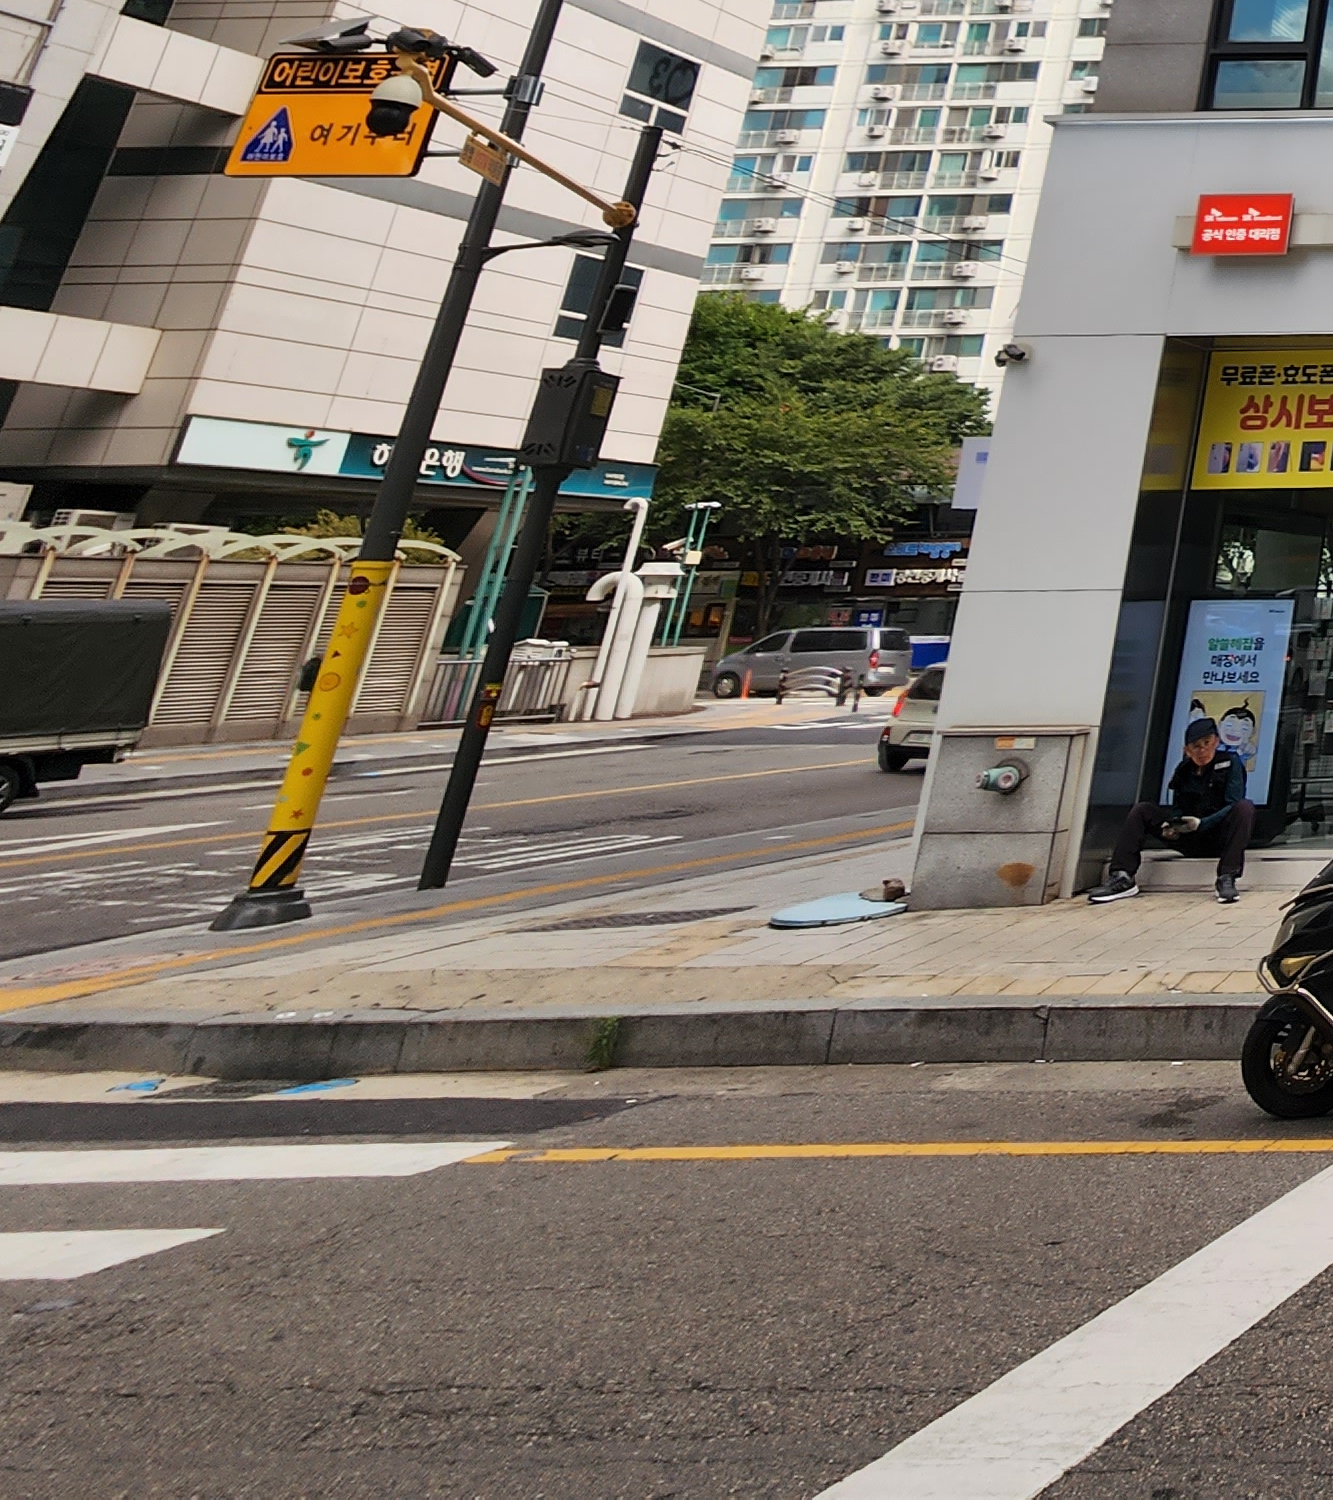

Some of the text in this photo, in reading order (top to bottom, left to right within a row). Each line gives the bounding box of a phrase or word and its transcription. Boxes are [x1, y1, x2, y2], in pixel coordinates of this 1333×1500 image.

[272, 55, 440, 87] 어린이보호
[372, 442, 463, 478] 하은행
[1202, 670, 1260, 685] 만나보세요
